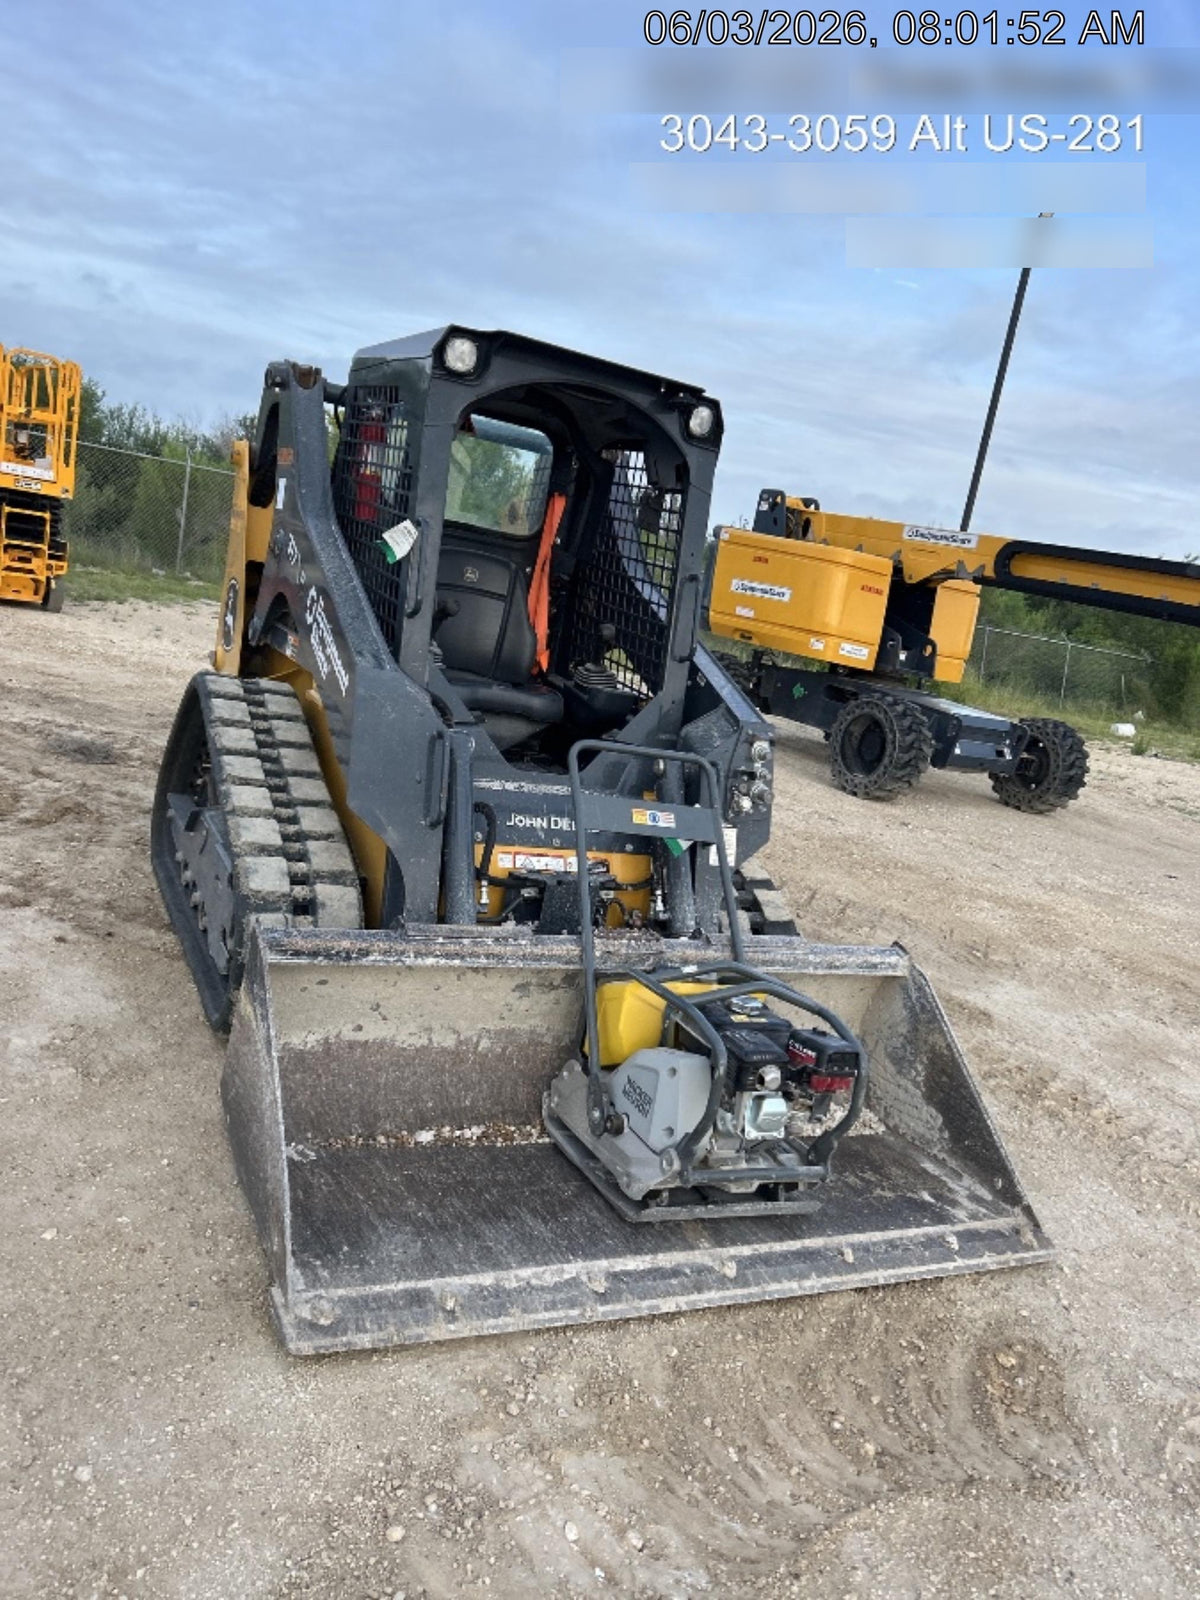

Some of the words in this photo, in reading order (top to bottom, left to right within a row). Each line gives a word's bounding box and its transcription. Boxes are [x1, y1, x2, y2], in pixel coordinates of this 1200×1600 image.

[506, 812, 548, 829] JOHN
[622, 1084, 650, 1118] NEUSON
[627, 1074, 653, 1109] WACKER
